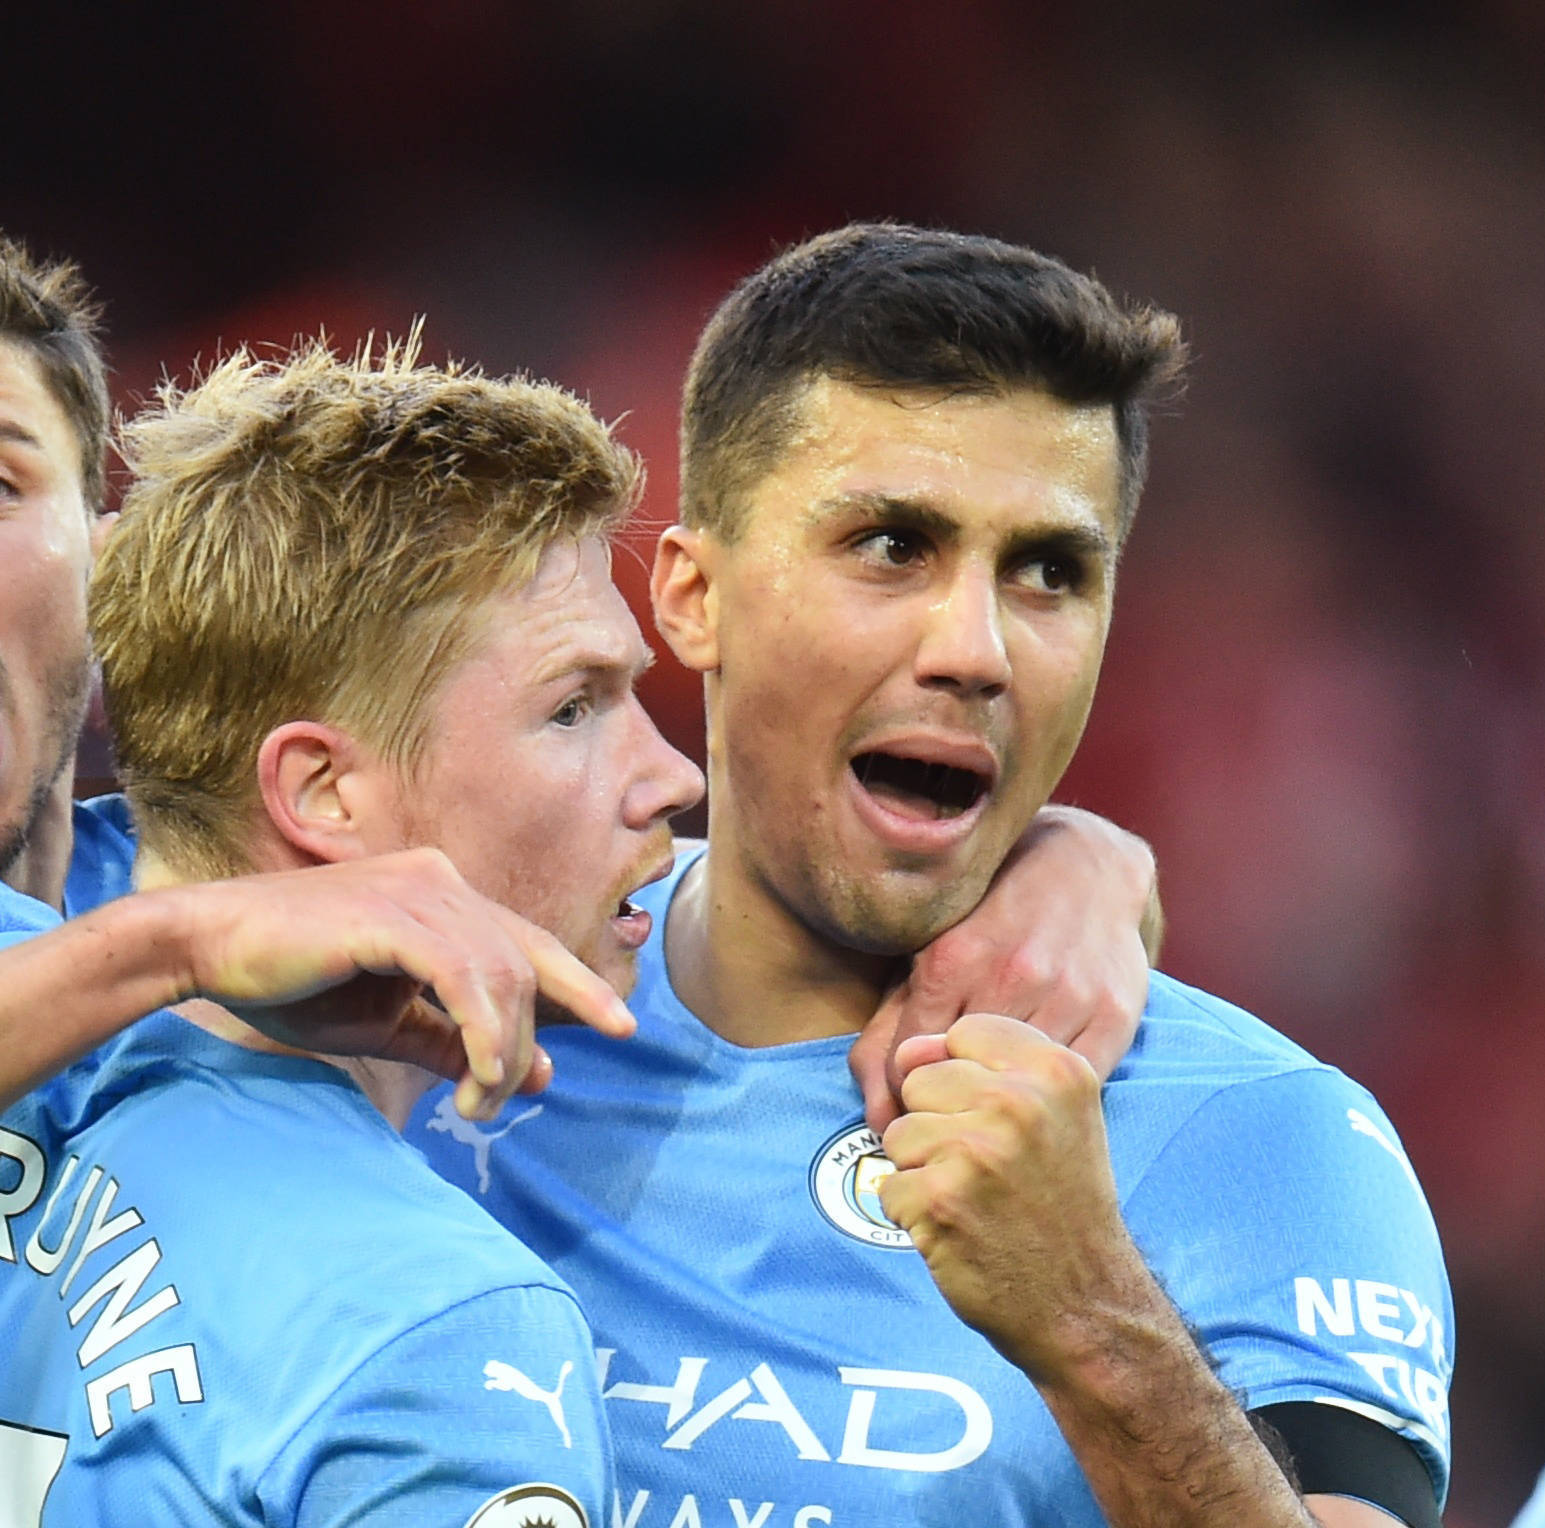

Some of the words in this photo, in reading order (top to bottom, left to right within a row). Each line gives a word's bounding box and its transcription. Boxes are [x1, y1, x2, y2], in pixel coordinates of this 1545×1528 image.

[870, 1230, 905, 1242] CIT
[596, 1348, 993, 1471] HAD
[1346, 1352, 1448, 1440] TIR
